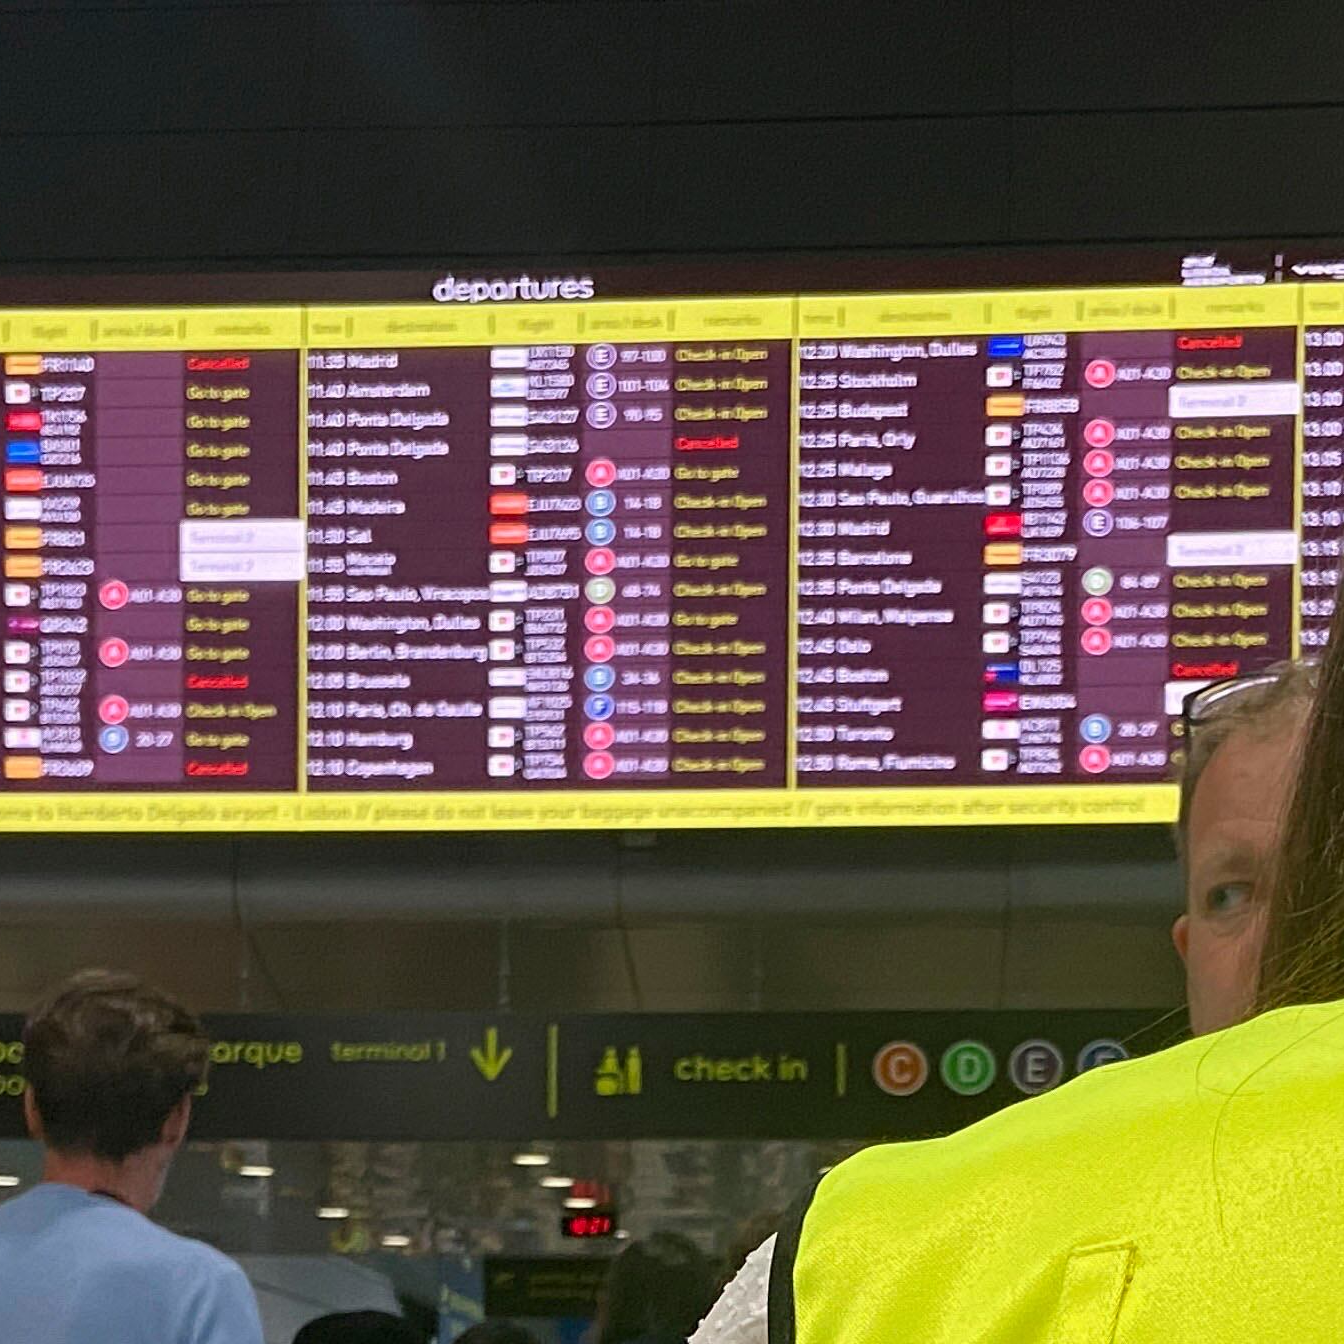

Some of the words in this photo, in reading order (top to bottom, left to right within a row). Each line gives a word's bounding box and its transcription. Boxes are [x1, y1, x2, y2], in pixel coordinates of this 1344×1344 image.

[433, 275, 595, 303] departures
[330, 1041, 433, 1063] terminal
[674, 1056, 770, 1082] check
[777, 1055, 808, 1081] in
[888, 1056, 911, 1083] C
[959, 1055, 980, 1083] D
[1027, 1055, 1045, 1083] E
